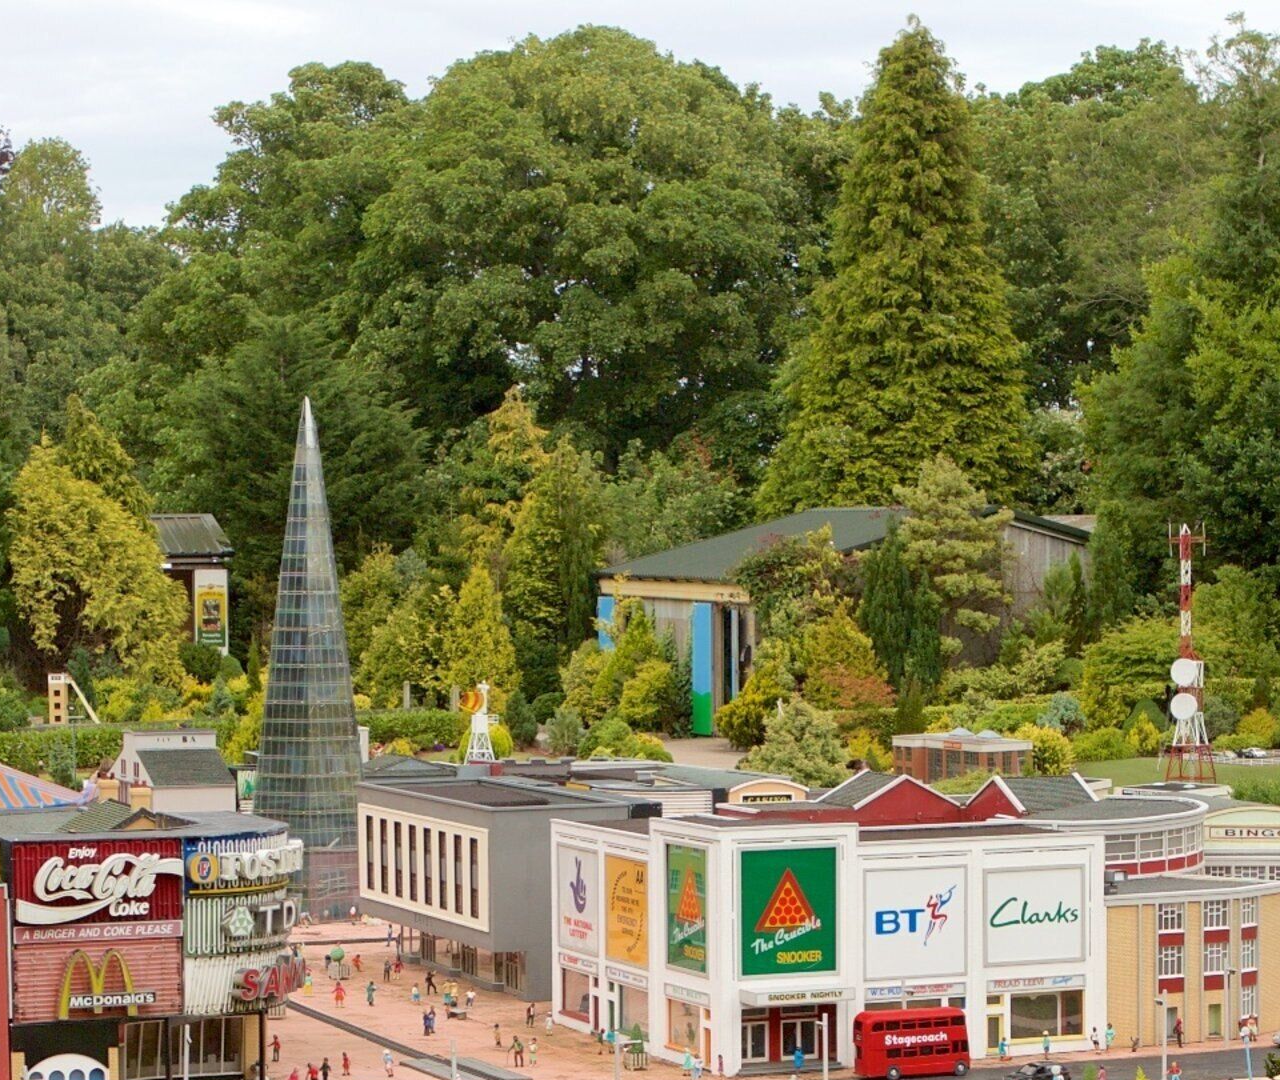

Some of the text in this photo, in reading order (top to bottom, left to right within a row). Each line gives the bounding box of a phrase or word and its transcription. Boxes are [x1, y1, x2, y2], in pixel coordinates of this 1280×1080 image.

[68, 846, 97, 860] Enjoy
[109, 899, 150, 917] Coke
[990, 897, 1078, 928] Clarks
[875, 908, 925, 935] BT
[22, 923, 173, 941] A BURGER AND COKE PLEASE
[750, 916, 821, 955] The Crucible
[777, 951, 822, 964] SNOOKER
[70, 992, 155, 1008] McDonald's
[768, 991, 843, 1001] SNOOKER NIGHTLY
[884, 1031, 947, 1047] Stagecoach
